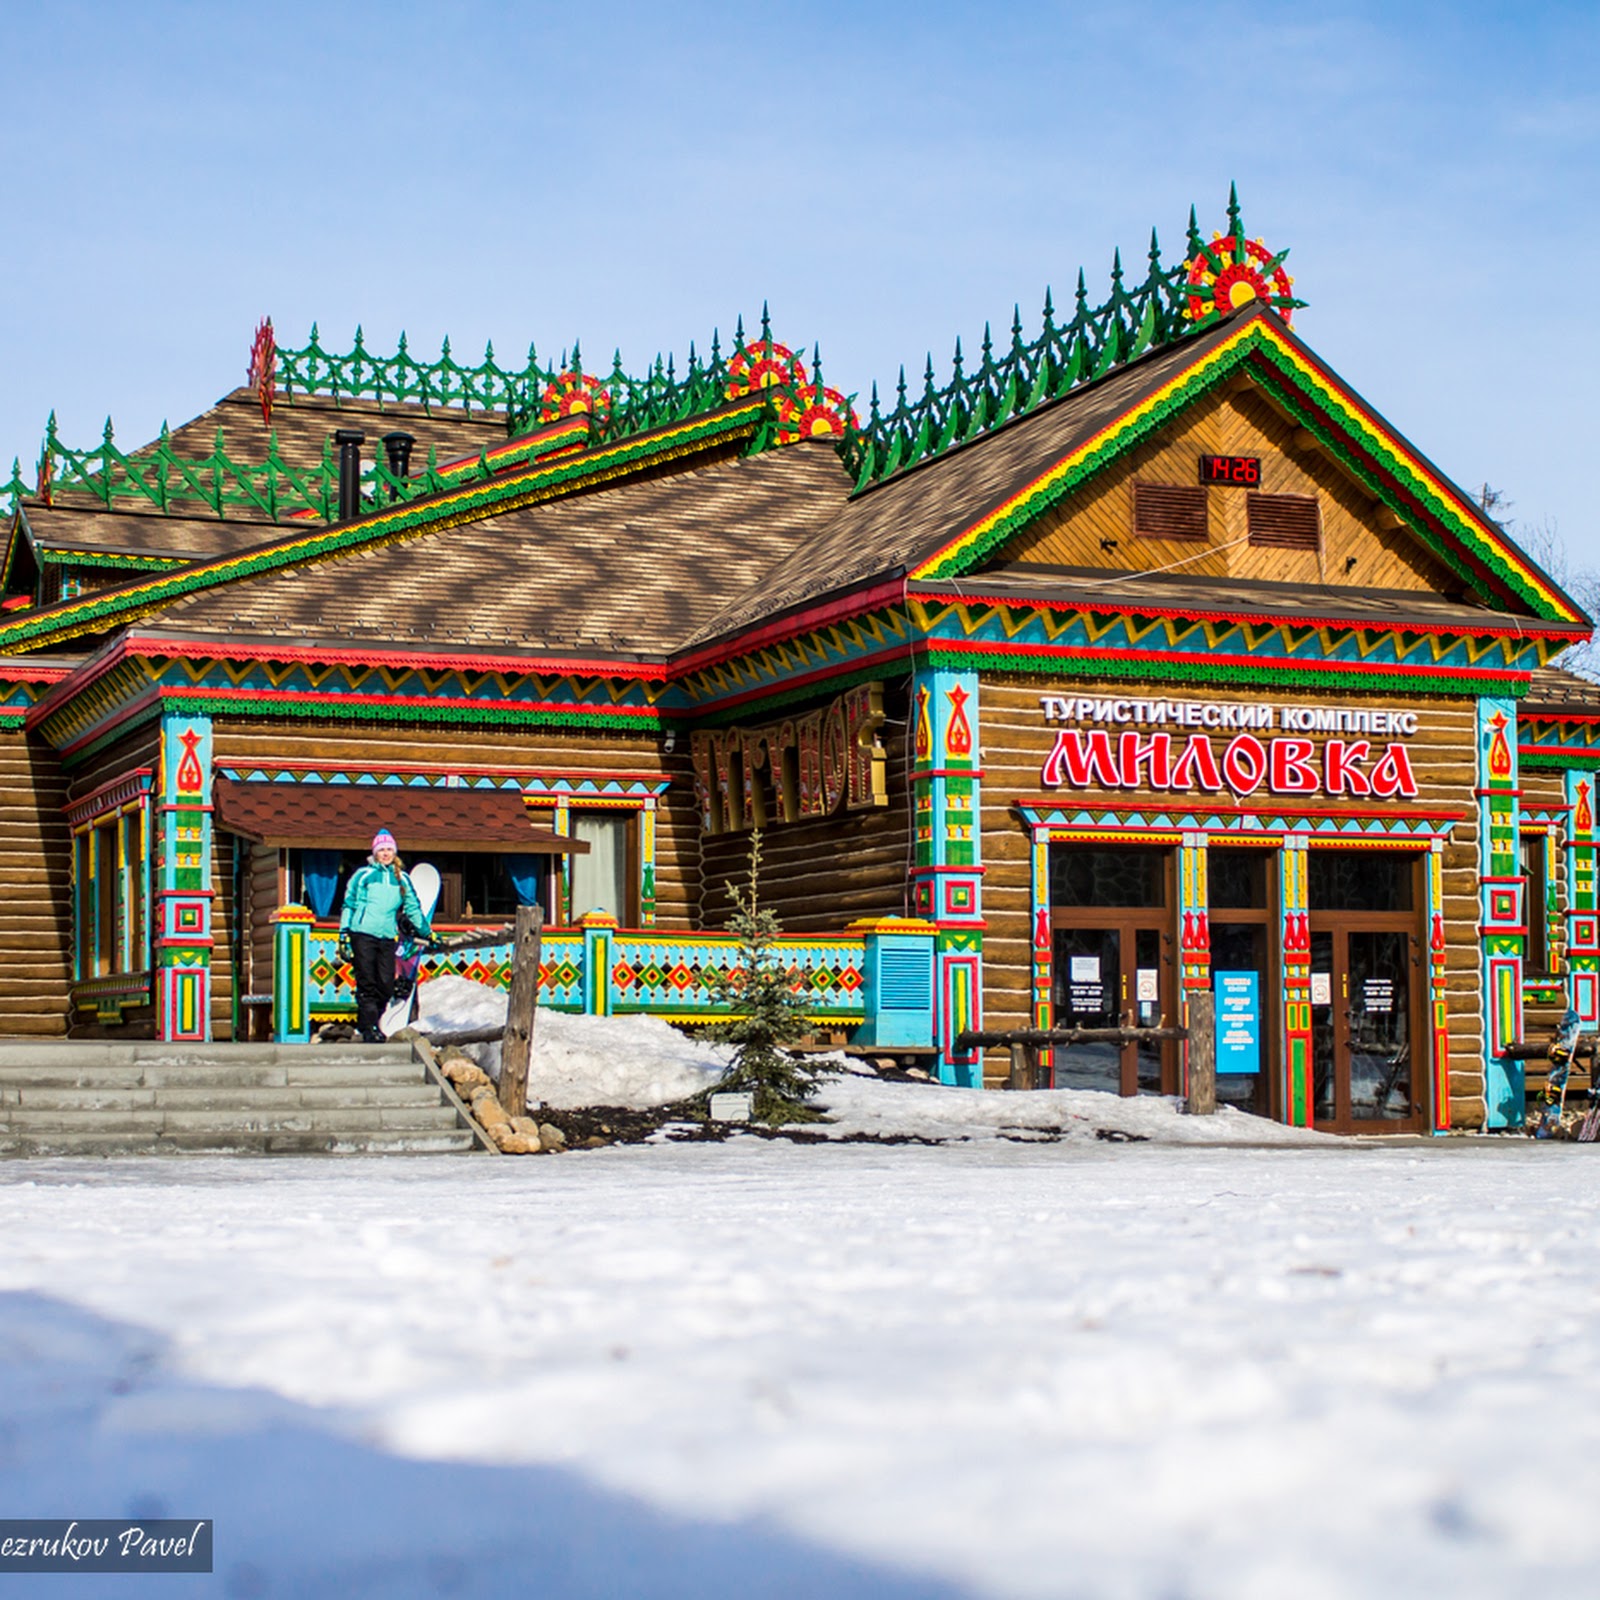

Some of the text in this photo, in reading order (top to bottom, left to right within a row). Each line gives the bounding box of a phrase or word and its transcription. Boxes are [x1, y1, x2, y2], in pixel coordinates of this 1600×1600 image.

[1040, 697, 1418, 734] ТУРИСТИЧЕСКИЙ КОМПЛЕКС
[1042, 729, 1419, 797] МИЛОВКА
